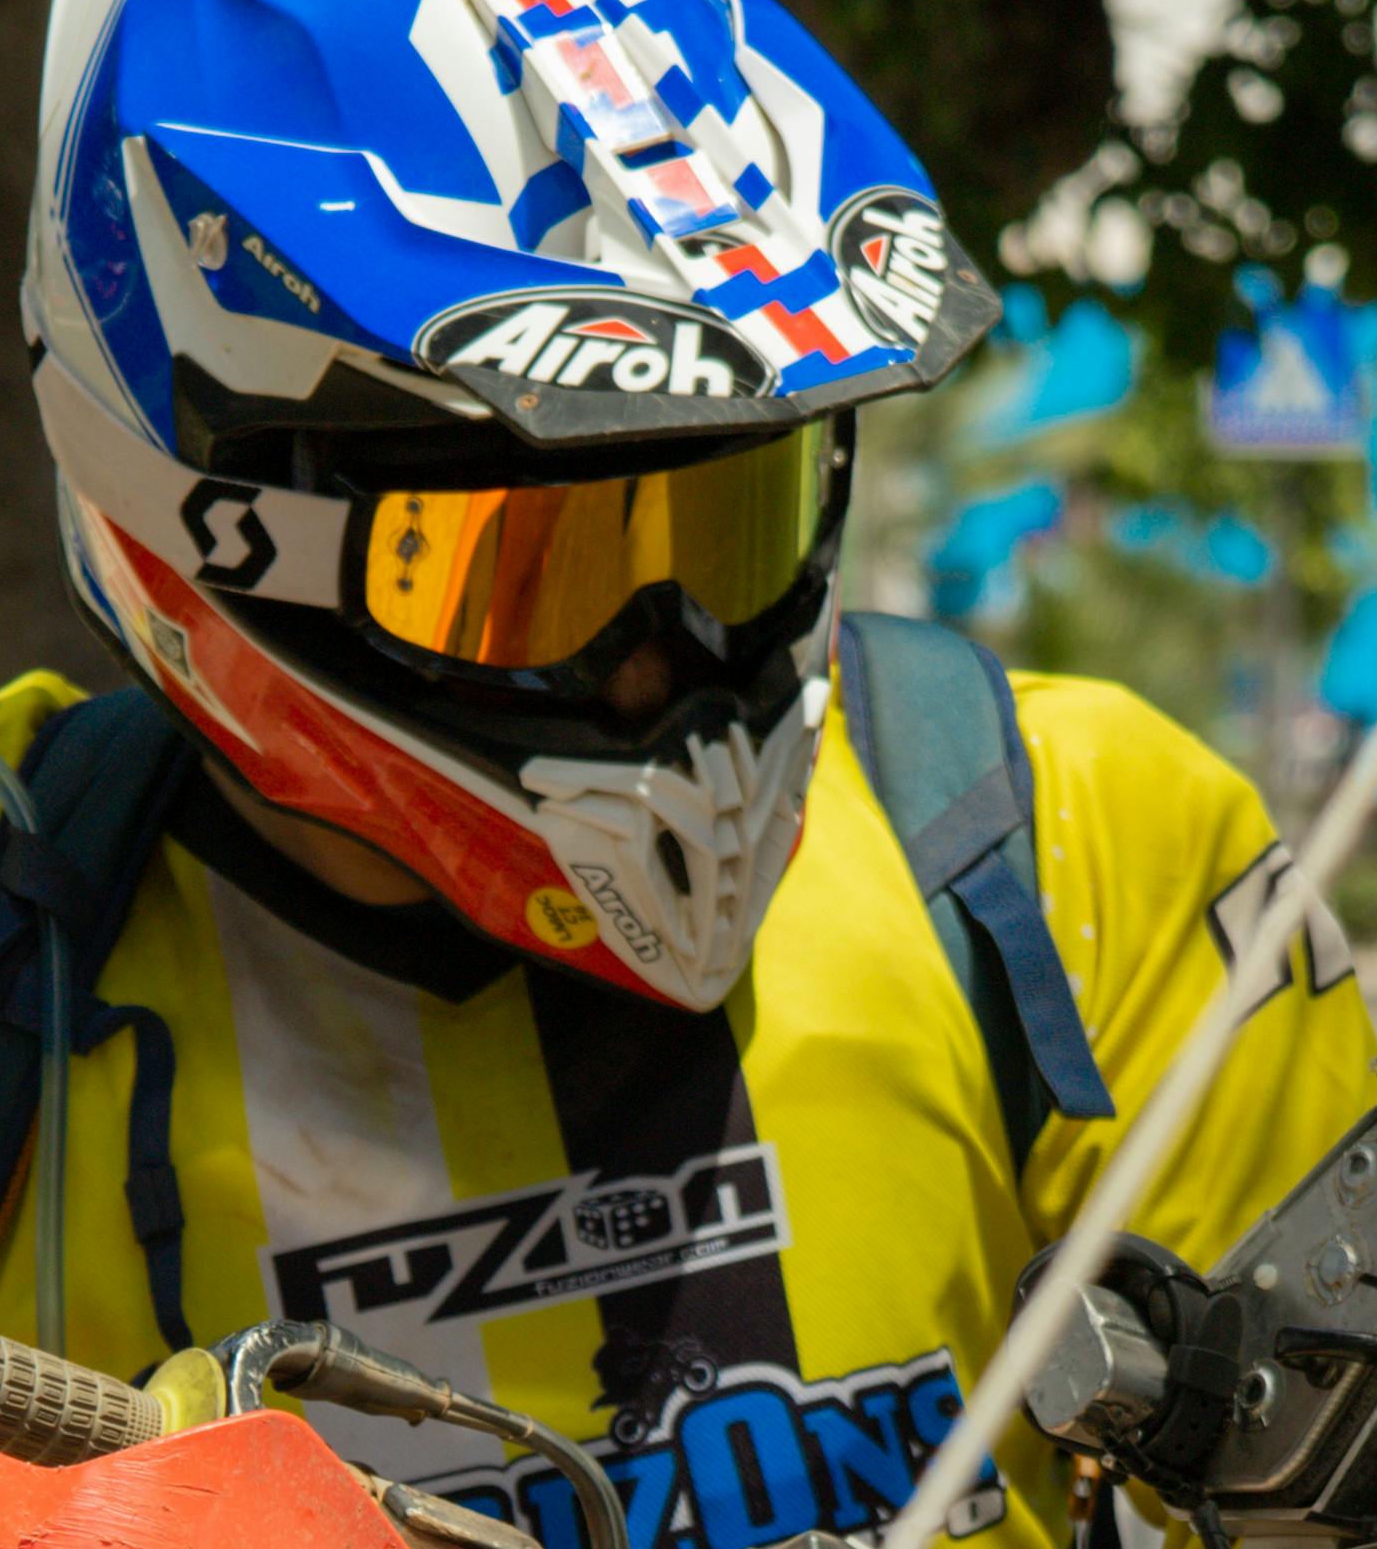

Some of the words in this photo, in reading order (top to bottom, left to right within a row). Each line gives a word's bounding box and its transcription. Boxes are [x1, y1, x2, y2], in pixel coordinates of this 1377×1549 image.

[242, 235, 320, 314] Airoh
[851, 208, 942, 344] Airoh
[449, 302, 734, 397] Airoh
[570, 864, 661, 963] Airoh
